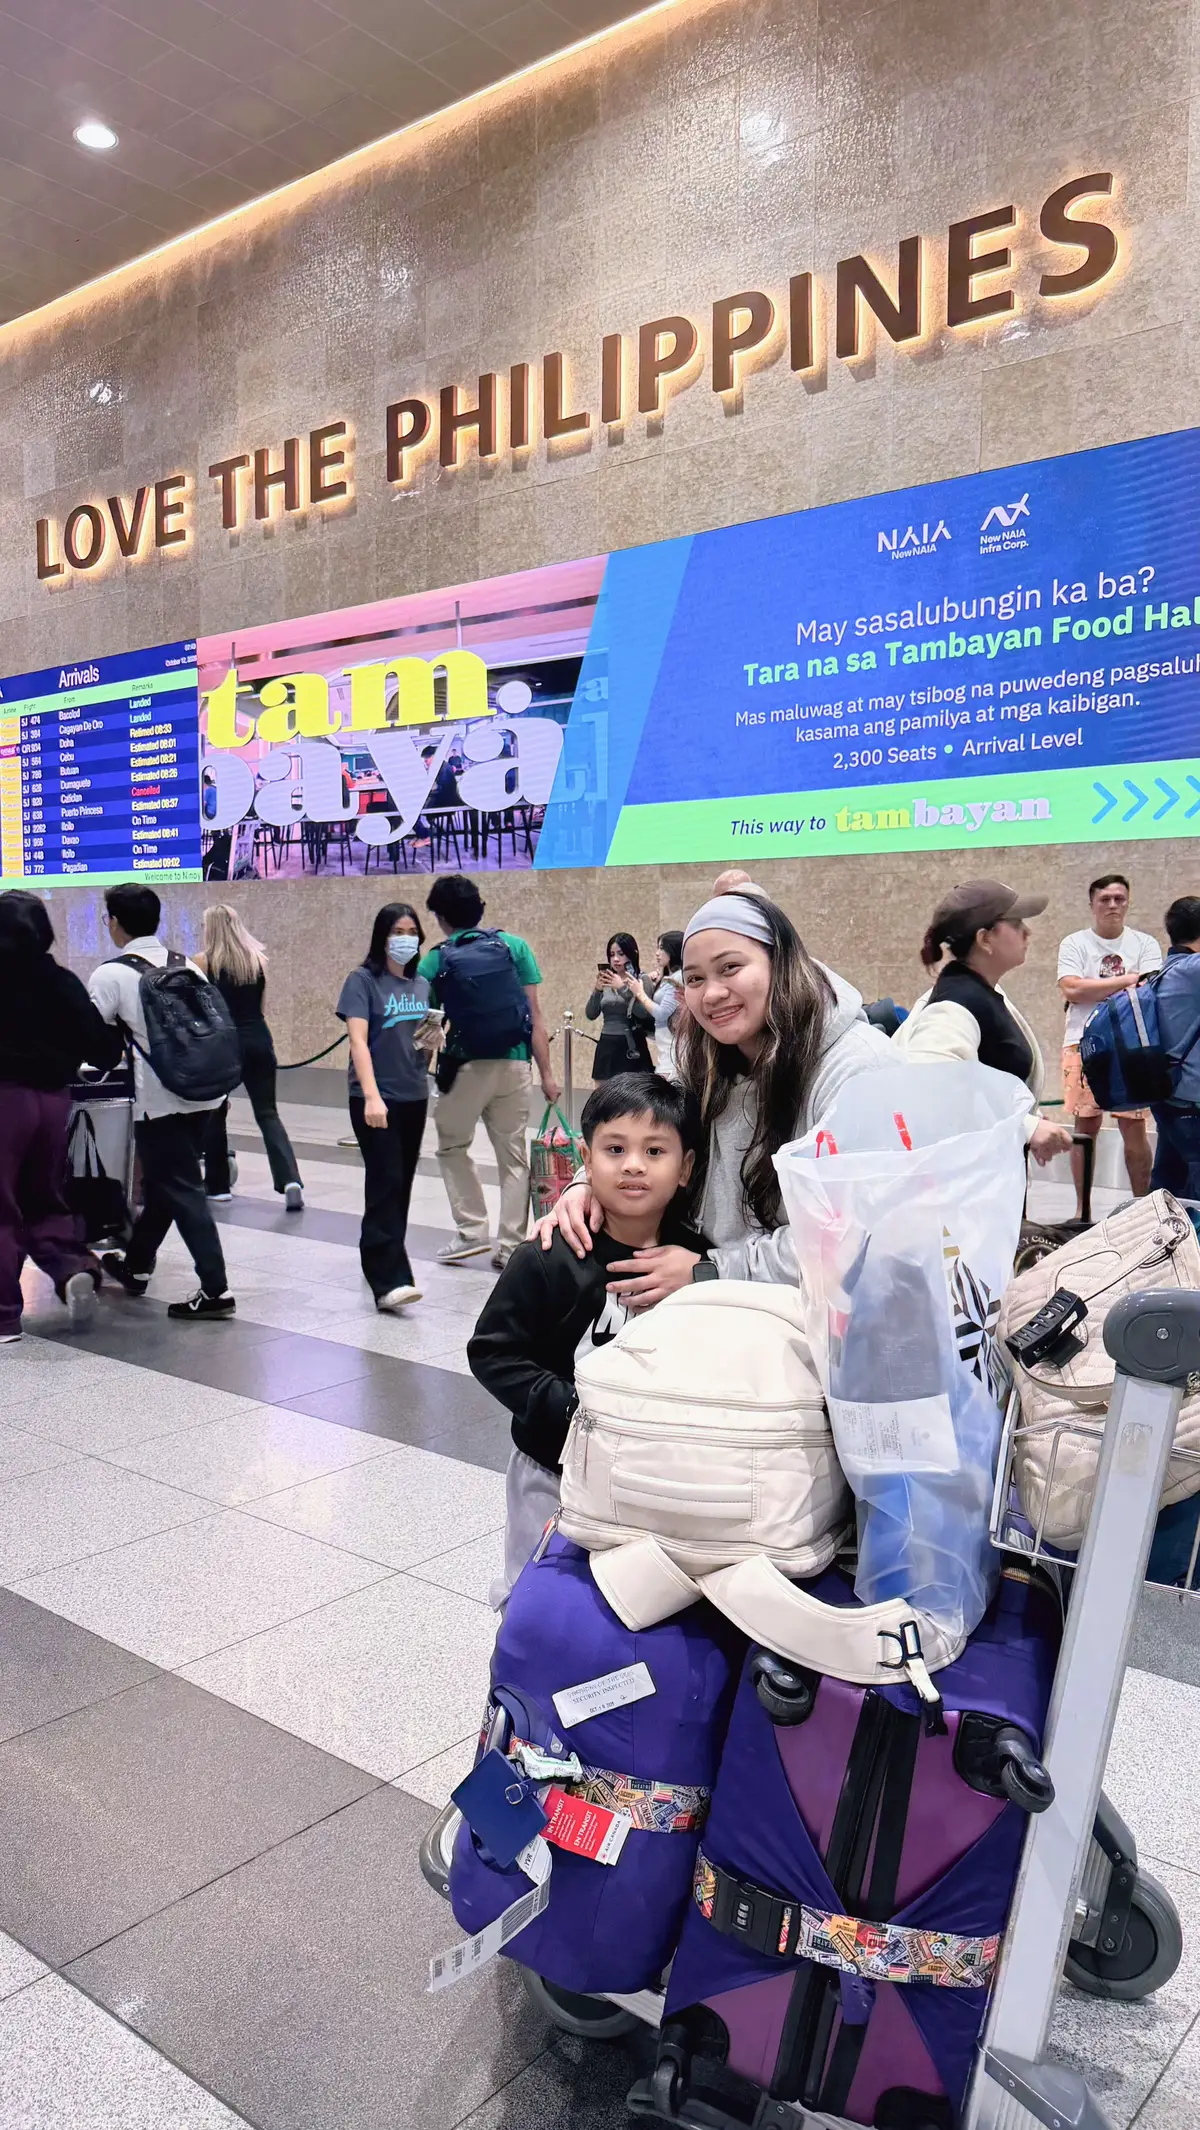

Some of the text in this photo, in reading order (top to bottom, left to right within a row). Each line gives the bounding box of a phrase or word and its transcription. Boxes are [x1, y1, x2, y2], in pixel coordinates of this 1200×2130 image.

[36, 172, 1119, 579] LOVE THE PHILIPPINES
[980, 529, 1026, 545] New NAIA
[980, 540, 1029, 554] Infra Corp.
[891, 544, 937, 560] New NAIA
[797, 566, 1156, 646] May sasalubungin ka ba?
[743, 663, 800, 687] Tara
[807, 656, 839, 677] na
[846, 651, 877, 672] sa
[885, 623, 1042, 667] Tambayan
[1052, 605, 1134, 644] Food
[58, 664, 100, 689] Arrivals
[132, 683, 154, 692] Remarks
[58, 708, 80, 720] Bacolod
[130, 696, 152, 709] Landed
[202, 649, 497, 749] tam
[735, 708, 767, 728] Mas
[770, 699, 844, 727] maluwag
[847, 695, 864, 714] at
[868, 692, 906, 718] may
[909, 683, 967, 709] tsibog
[971, 682, 995, 700] na
[999, 666, 1105, 700] puwedeng
[59, 724, 82, 736] Cagayan
[83, 722, 92, 730] De
[92, 720, 104, 729] Oro
[130, 712, 152, 724] Landed
[796, 690, 1141, 744] kasama ang pamilya at mga kaibigan.
[60, 738, 74, 748] Doha
[60, 752, 74, 762] Cebu
[130, 740, 160, 752] Estimated
[833, 728, 1083, 771] 2,300 Seats Arrival Level
[60, 766, 80, 776] Butuan
[130, 755, 160, 768] Estimated
[60, 779, 92, 790] Dumaguete
[130, 770, 160, 782] Estimated
[132, 784, 160, 796] Cancelled
[61, 807, 79, 818] Puerto
[79, 806, 104, 816] Princesa
[132, 800, 160, 811] Estimated
[132, 816, 142, 826] On
[142, 814, 157, 825] Time
[730, 797, 1052, 839] This way to tambayan
[62, 836, 80, 845] Davao
[132, 829, 162, 840] Estimated
[132, 844, 142, 854] On
[142, 844, 158, 854] Time
[62, 862, 88, 874] Pagadian
[132, 858, 162, 869] Estimated
[145, 871, 200, 882] Welcome to Ninoy
[573, 1678, 634, 1704] SECURITY INSPECTED
[550, 1798, 565, 1826] TRANSIT
[641, 1802, 654, 1827] CINEMA
[546, 1823, 556, 1834] IN
[578, 1810, 593, 1839] TRANSIT
[608, 1820, 622, 1844] CANADA
[573, 1834, 584, 1847] EN
[524, 1853, 533, 1866] YVR
[907, 1940, 922, 1964] CINEMA
